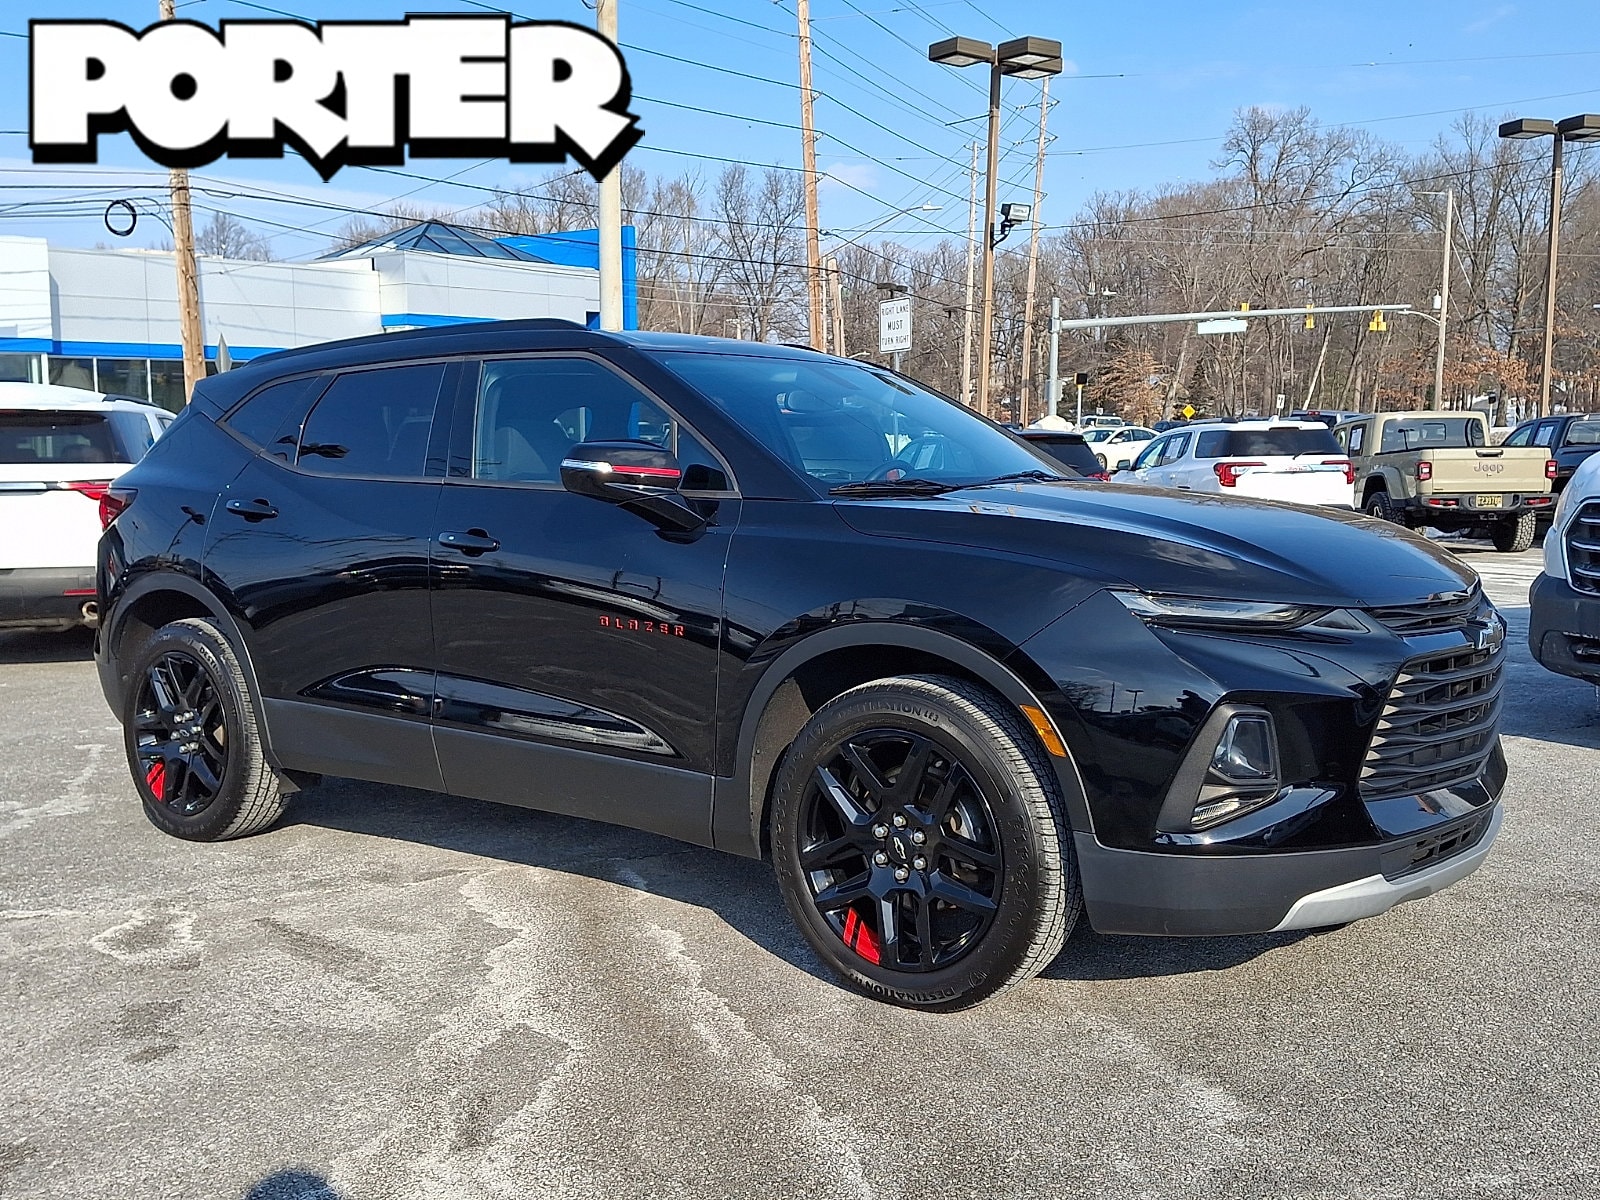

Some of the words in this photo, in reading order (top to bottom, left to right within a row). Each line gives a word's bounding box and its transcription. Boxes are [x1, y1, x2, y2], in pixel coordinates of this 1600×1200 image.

[881, 306, 894, 316] RIGHT
[896, 304, 909, 314] LANE
[887, 319, 903, 331] MUST
[881, 337, 894, 346] TURN
[895, 334, 909, 344] RIGHT
[1473, 461, 1504, 474] Jeep
[599, 615, 685, 636] BLAZER
[865, 980, 956, 1003] DESTINATION
